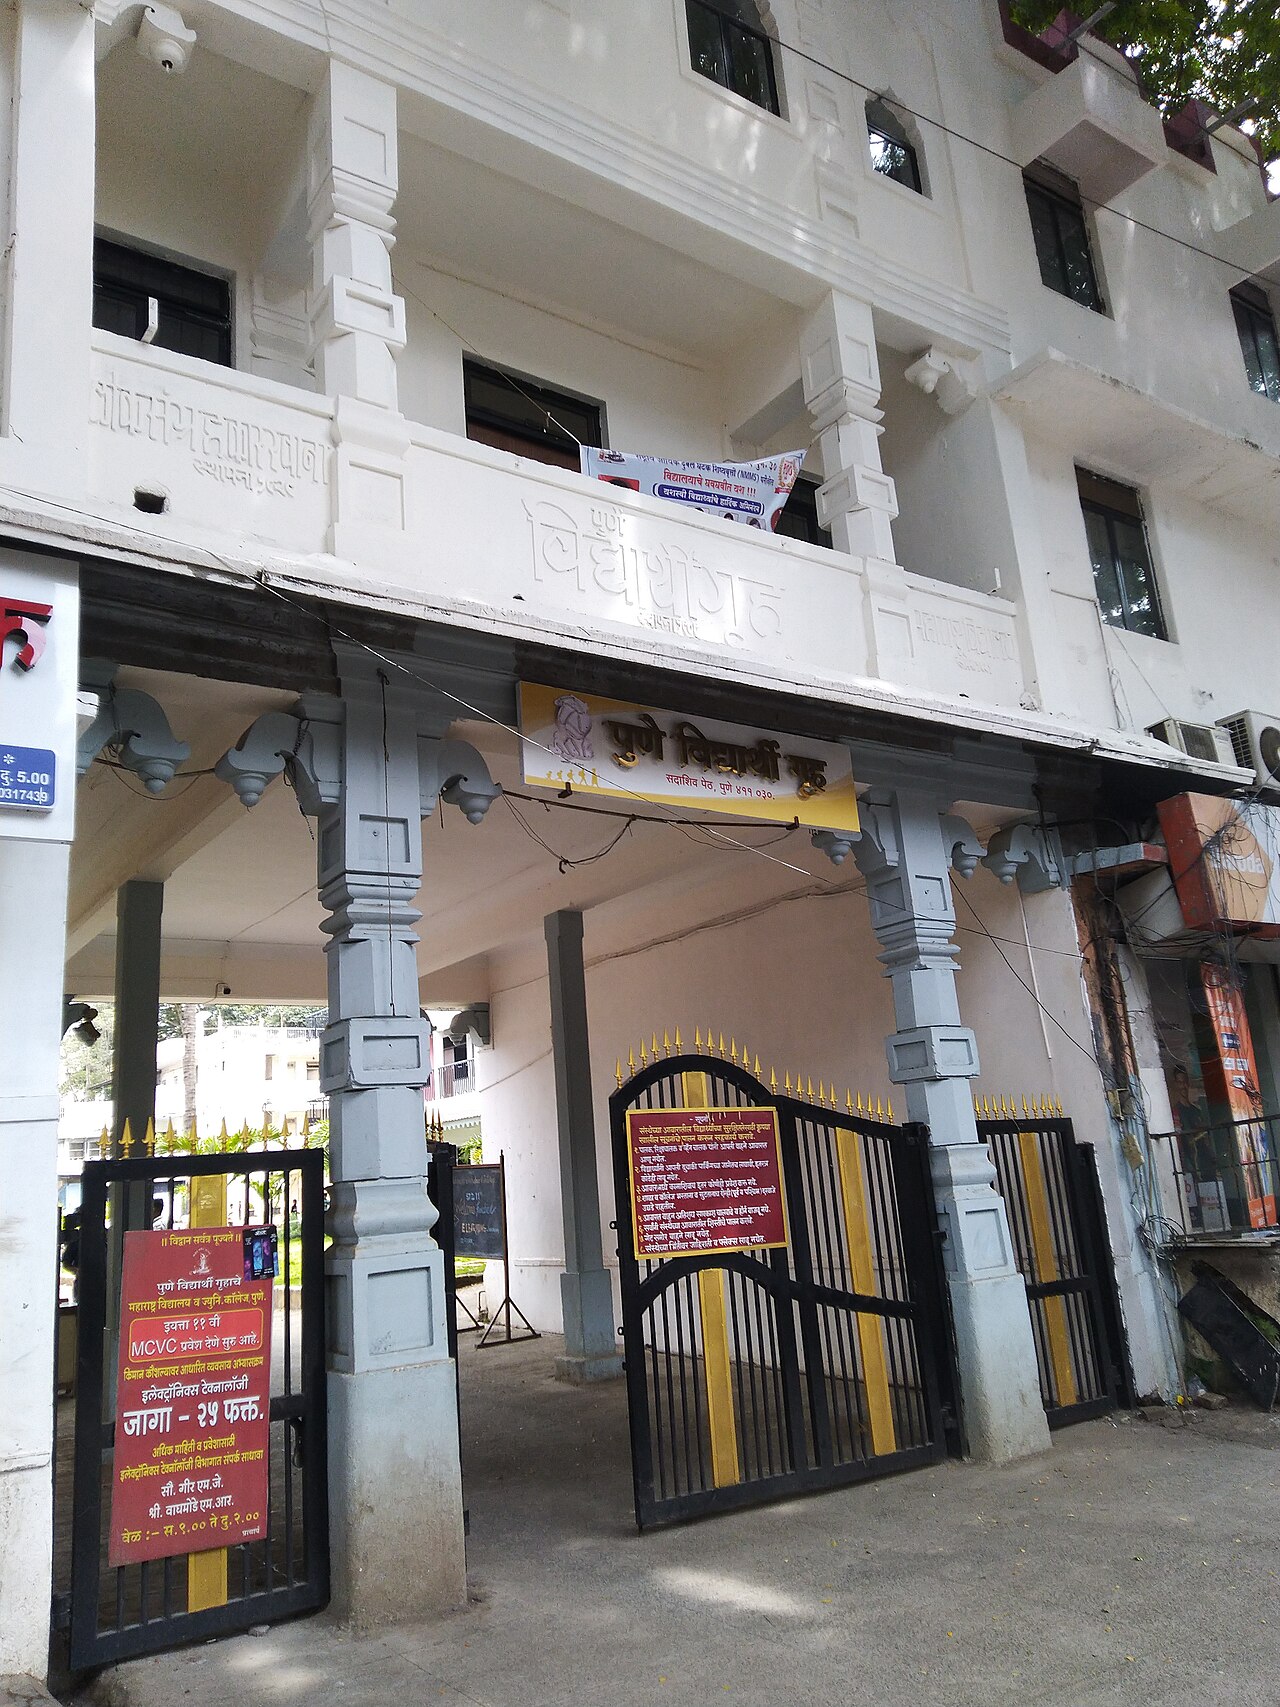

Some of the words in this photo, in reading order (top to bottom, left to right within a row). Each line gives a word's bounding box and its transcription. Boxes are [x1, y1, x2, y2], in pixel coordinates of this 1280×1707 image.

[663, 469, 702, 486] विद्यालयाचे
[705, 477, 732, 493] घवघवीत
[733, 483, 745, 494] यश
[663, 487, 687, 499] यशस्वी
[601, 714, 666, 768] पुणे
[670, 722, 782, 783] विद्यार्थी
[784, 754, 828, 800] गृह
[17, 771, 49, 785] 5.00
[666, 773, 698, 789] सदाशिव
[701, 776, 716, 792] पेठ,
[720, 779, 733, 795] पुणे
[736, 784, 753, 797] ४११
[756, 788, 775, 800] ०३०.
[170, 1235, 191, 1246] विद्वान
[193, 1233, 210, 1244] सर्वत्र
[213, 1231, 233, 1246] पूज्यते
[157, 1280, 174, 1295] पुणे
[177, 1277, 213, 1291] विद्यार्थी
[215, 1275, 241, 1291] गृहाचे
[128, 1301, 157, 1314] महाराष्ट्र
[158, 1297, 191, 1310] विद्यालय
[194, 1298, 199, 1307] व
[251, 1291, 266, 1306] पुणे.
[164, 1319, 189, 1334] इयत्ता
[193, 1318, 206, 1331] ११
[209, 1314, 221, 1327] वी
[131, 1337, 177, 1357] MCVC
[180, 1339, 202, 1352] प्रवेश
[206, 1335, 219, 1349] देणे
[222, 1336, 236, 1349] सुरु
[239, 1331, 259, 1345] आहे.
[124, 1367, 144, 1382] किमान
[145, 1364, 179, 1379] कौशल्यावर
[180, 1362, 205, 1374] आधारित
[207, 1359, 231, 1372] व्यवसाय
[233, 1356, 264, 1369] अभ्यासक्रम
[142, 1382, 199, 1404] इलेक्ट्रॉनिक्स
[123, 1406, 173, 1437] जागा
[197, 1401, 219, 1428] २५
[223, 1395, 264, 1424] फक्त.
[152, 1443, 173, 1458] अधिक
[175, 1439, 195, 1455] माहिती
[196, 1441, 202, 1451] व
[203, 1434, 236, 1452] प्रवेशासाठी
[120, 1463, 160, 1483] इलेक्ट्रॉनिक्स
[194, 1454, 222, 1469] विभागात
[223, 1450, 240, 1464] संपर्क
[242, 1450, 264, 1462] साधावा
[161, 1481, 176, 1497] सौ.
[179, 1478, 195, 1494] गीर
[149, 1503, 163, 1519] श्री.
[165, 1498, 199, 1517] वाघमोडे
[121, 1528, 142, 1544] वेळ
[209, 1513, 218, 1528] ते
